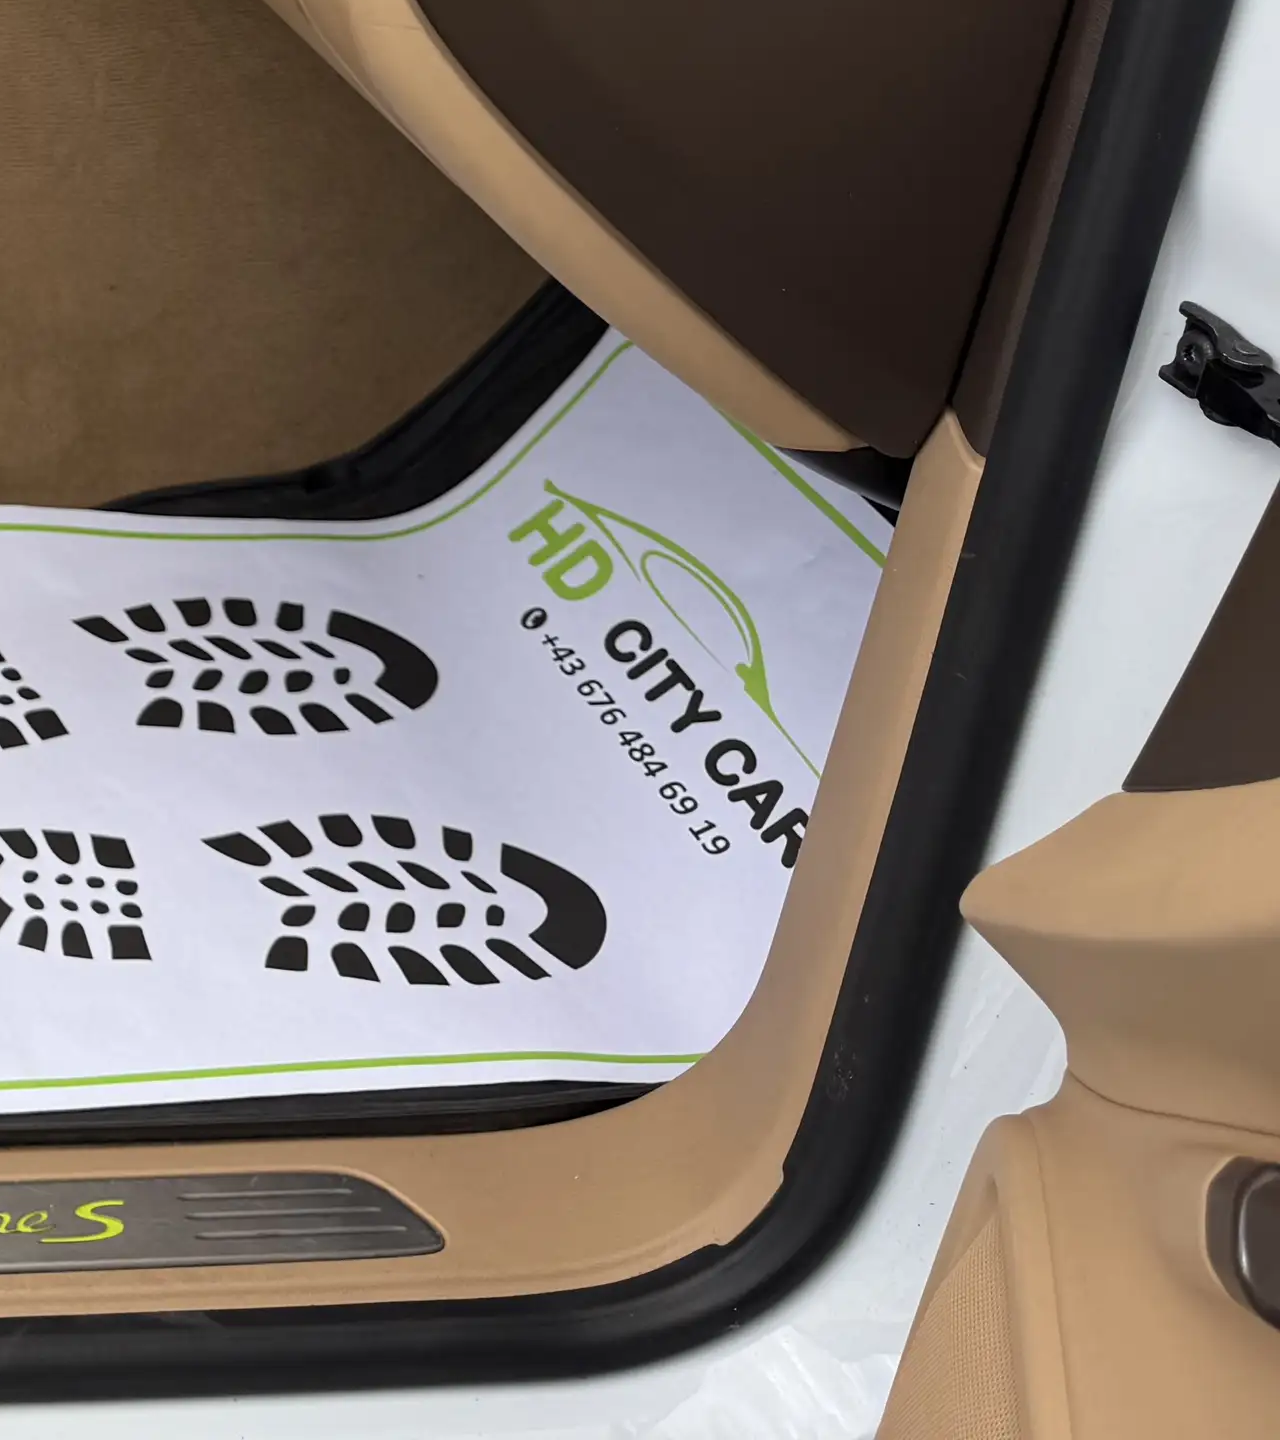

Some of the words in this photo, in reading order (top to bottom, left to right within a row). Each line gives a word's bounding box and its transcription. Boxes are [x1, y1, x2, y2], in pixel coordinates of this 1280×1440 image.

[508, 499, 613, 601] HD
[604, 619, 722, 733] CITY
[541, 634, 586, 676] +43
[577, 679, 627, 725] 676
[618, 730, 668, 777] 484
[658, 781, 699, 815] 69
[688, 820, 731, 856] 19
[39, 1199, 125, 1244] S
